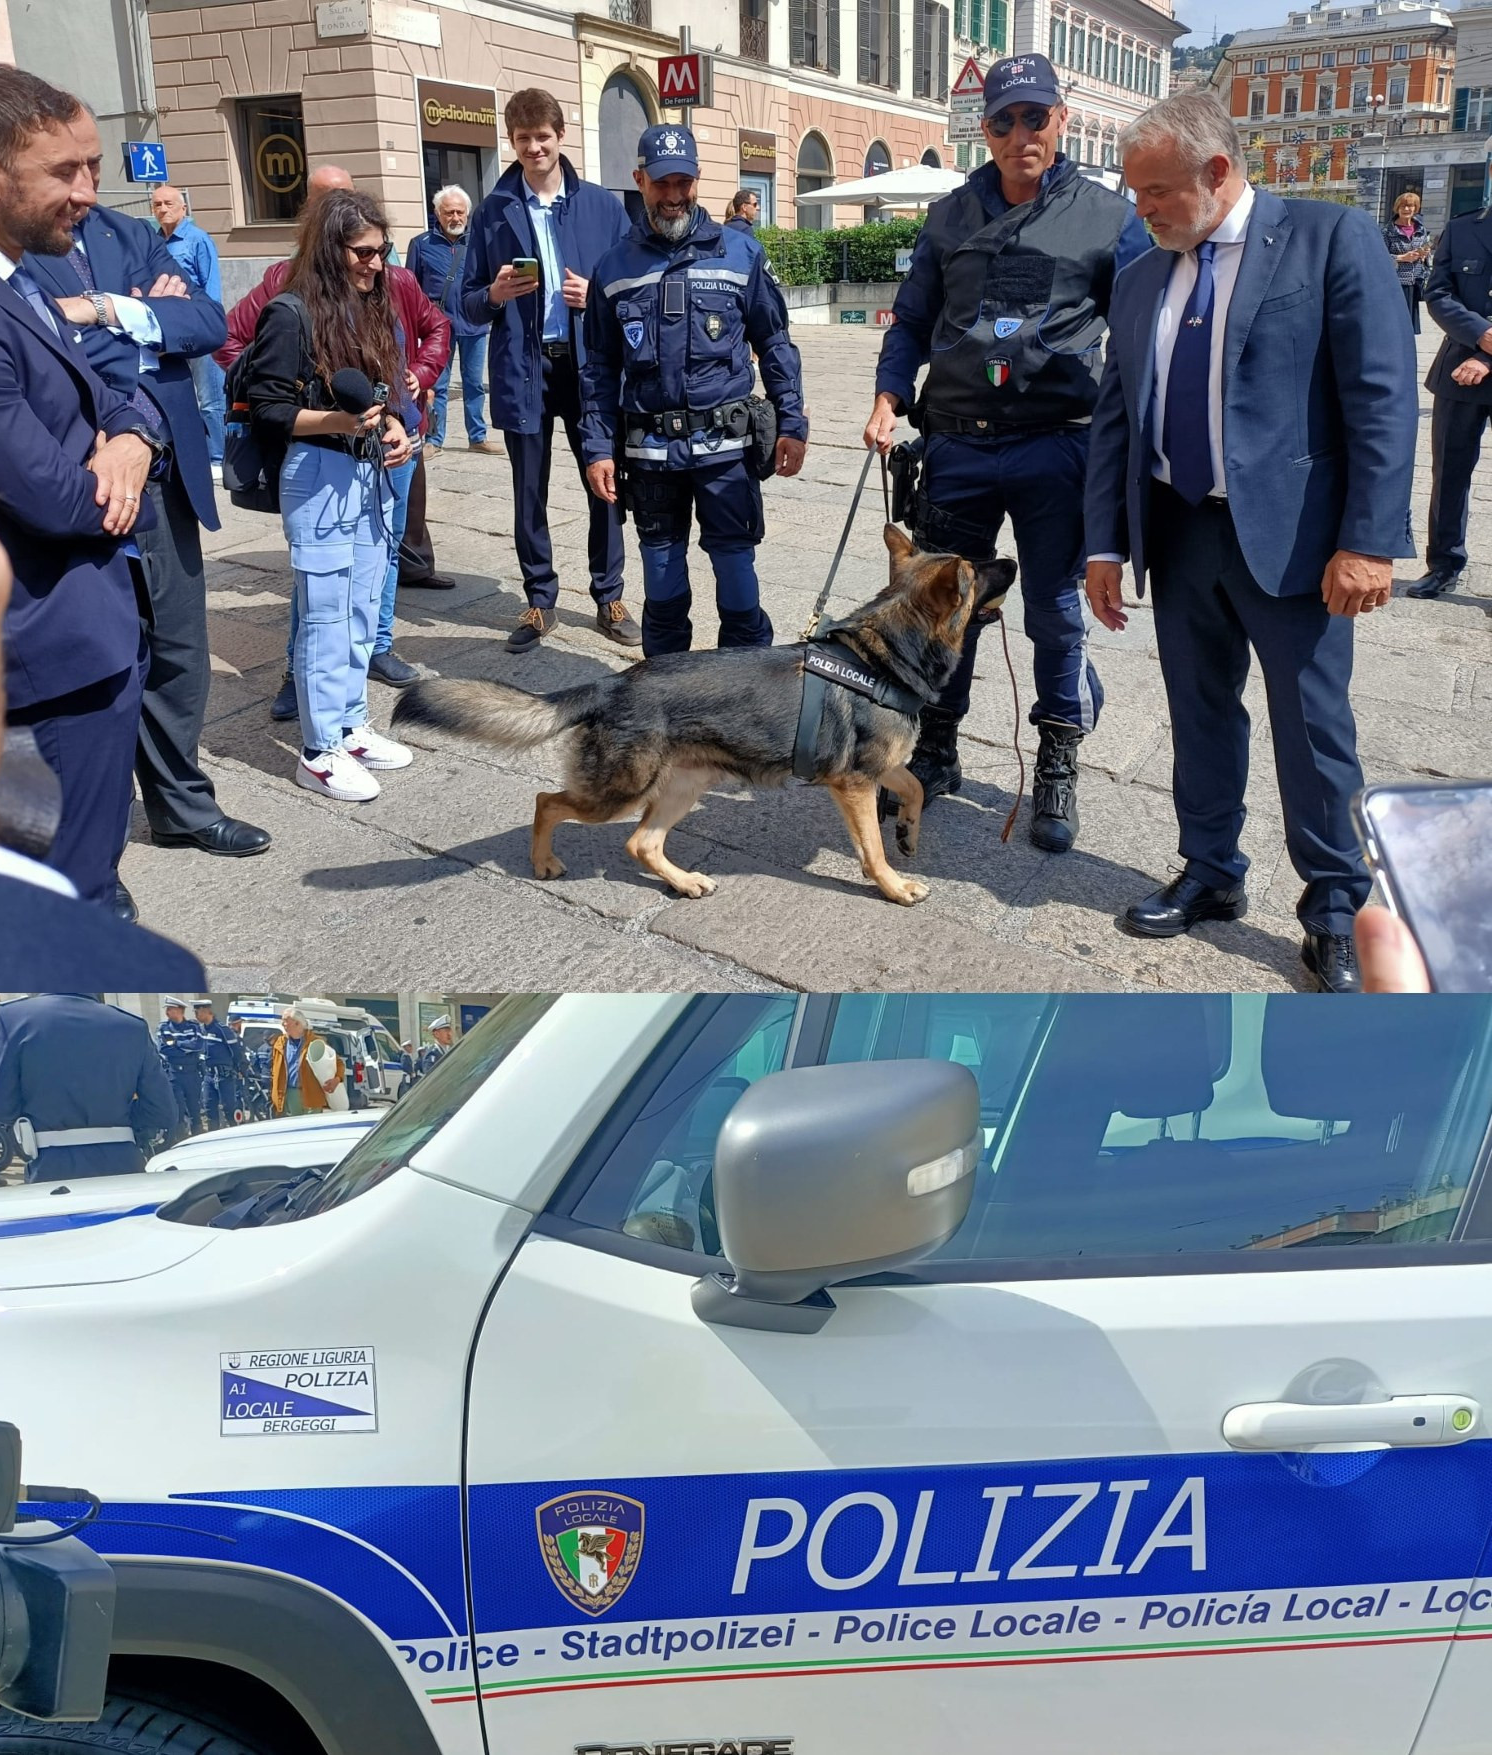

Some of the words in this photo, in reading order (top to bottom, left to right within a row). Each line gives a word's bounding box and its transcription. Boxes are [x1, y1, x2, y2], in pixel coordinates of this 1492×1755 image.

[321, 20, 364, 31] FONDACO
[1000, 58, 1036, 73] POLIZIA
[663, 61, 696, 93] M
[1001, 76, 1037, 90] LOCALE
[426, 102, 496, 124] mediolanum
[657, 148, 687, 156] LOCALE
[691, 281, 717, 290] POLIZIA
[808, 656, 840, 675] POLIZIA
[841, 667, 876, 688] LOCALE
[249, 1352, 309, 1367] REGIONE
[313, 1351, 366, 1364] LIGURIA
[285, 1371, 369, 1388] POLIZIA
[229, 1382, 247, 1395] A1
[225, 1401, 294, 1418] LOCALE
[263, 1418, 336, 1432] BERGEGGI
[554, 1501, 625, 1517] POLIZIA
[564, 1513, 618, 1526] LOCALE
[731, 1476, 1207, 1595] POLIZIA
[561, 1618, 797, 1661] Stadtpolizei
[833, 1613, 957, 1644] Police
[969, 1605, 1101, 1639] Locale
[1139, 1594, 1271, 1630] Policía
[1283, 1589, 1390, 1622] Local
[1421, 1586, 1492, 1614] Loc
